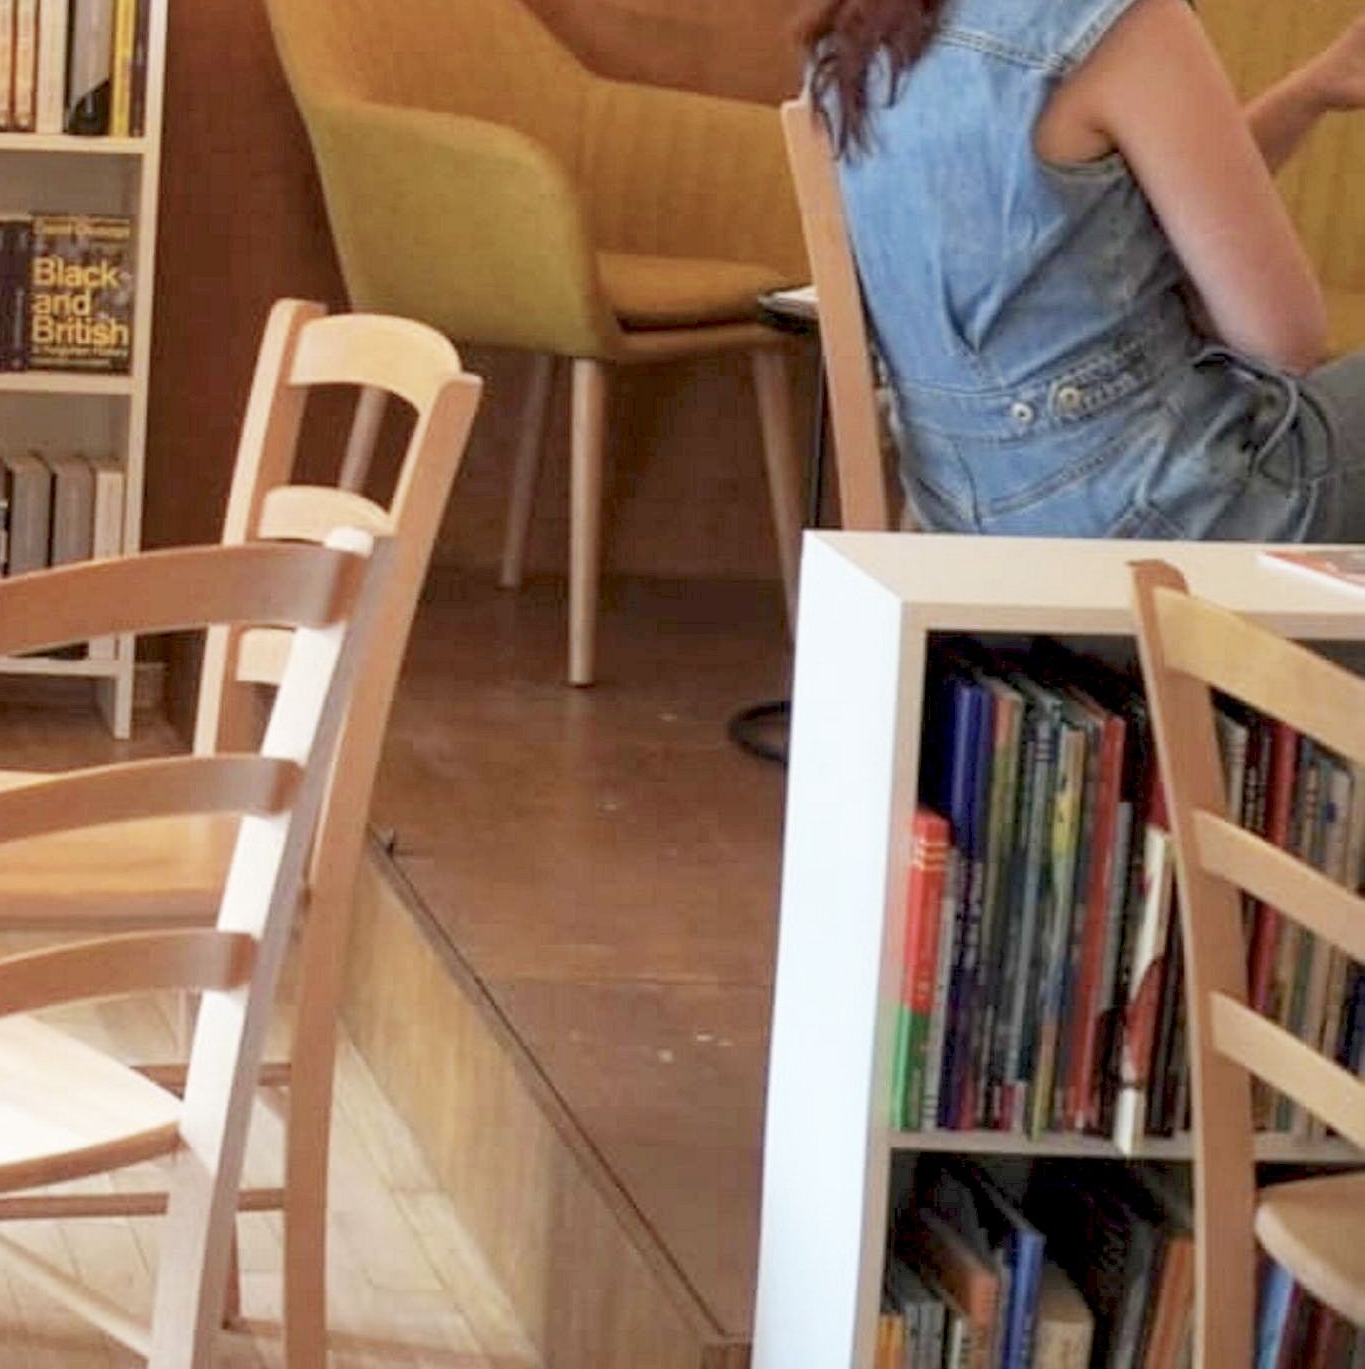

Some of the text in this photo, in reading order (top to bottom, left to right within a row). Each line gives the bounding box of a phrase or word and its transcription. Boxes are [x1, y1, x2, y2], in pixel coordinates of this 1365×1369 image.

[32, 255, 121, 288] Black
[32, 288, 91, 316] and
[32, 316, 128, 346] British
